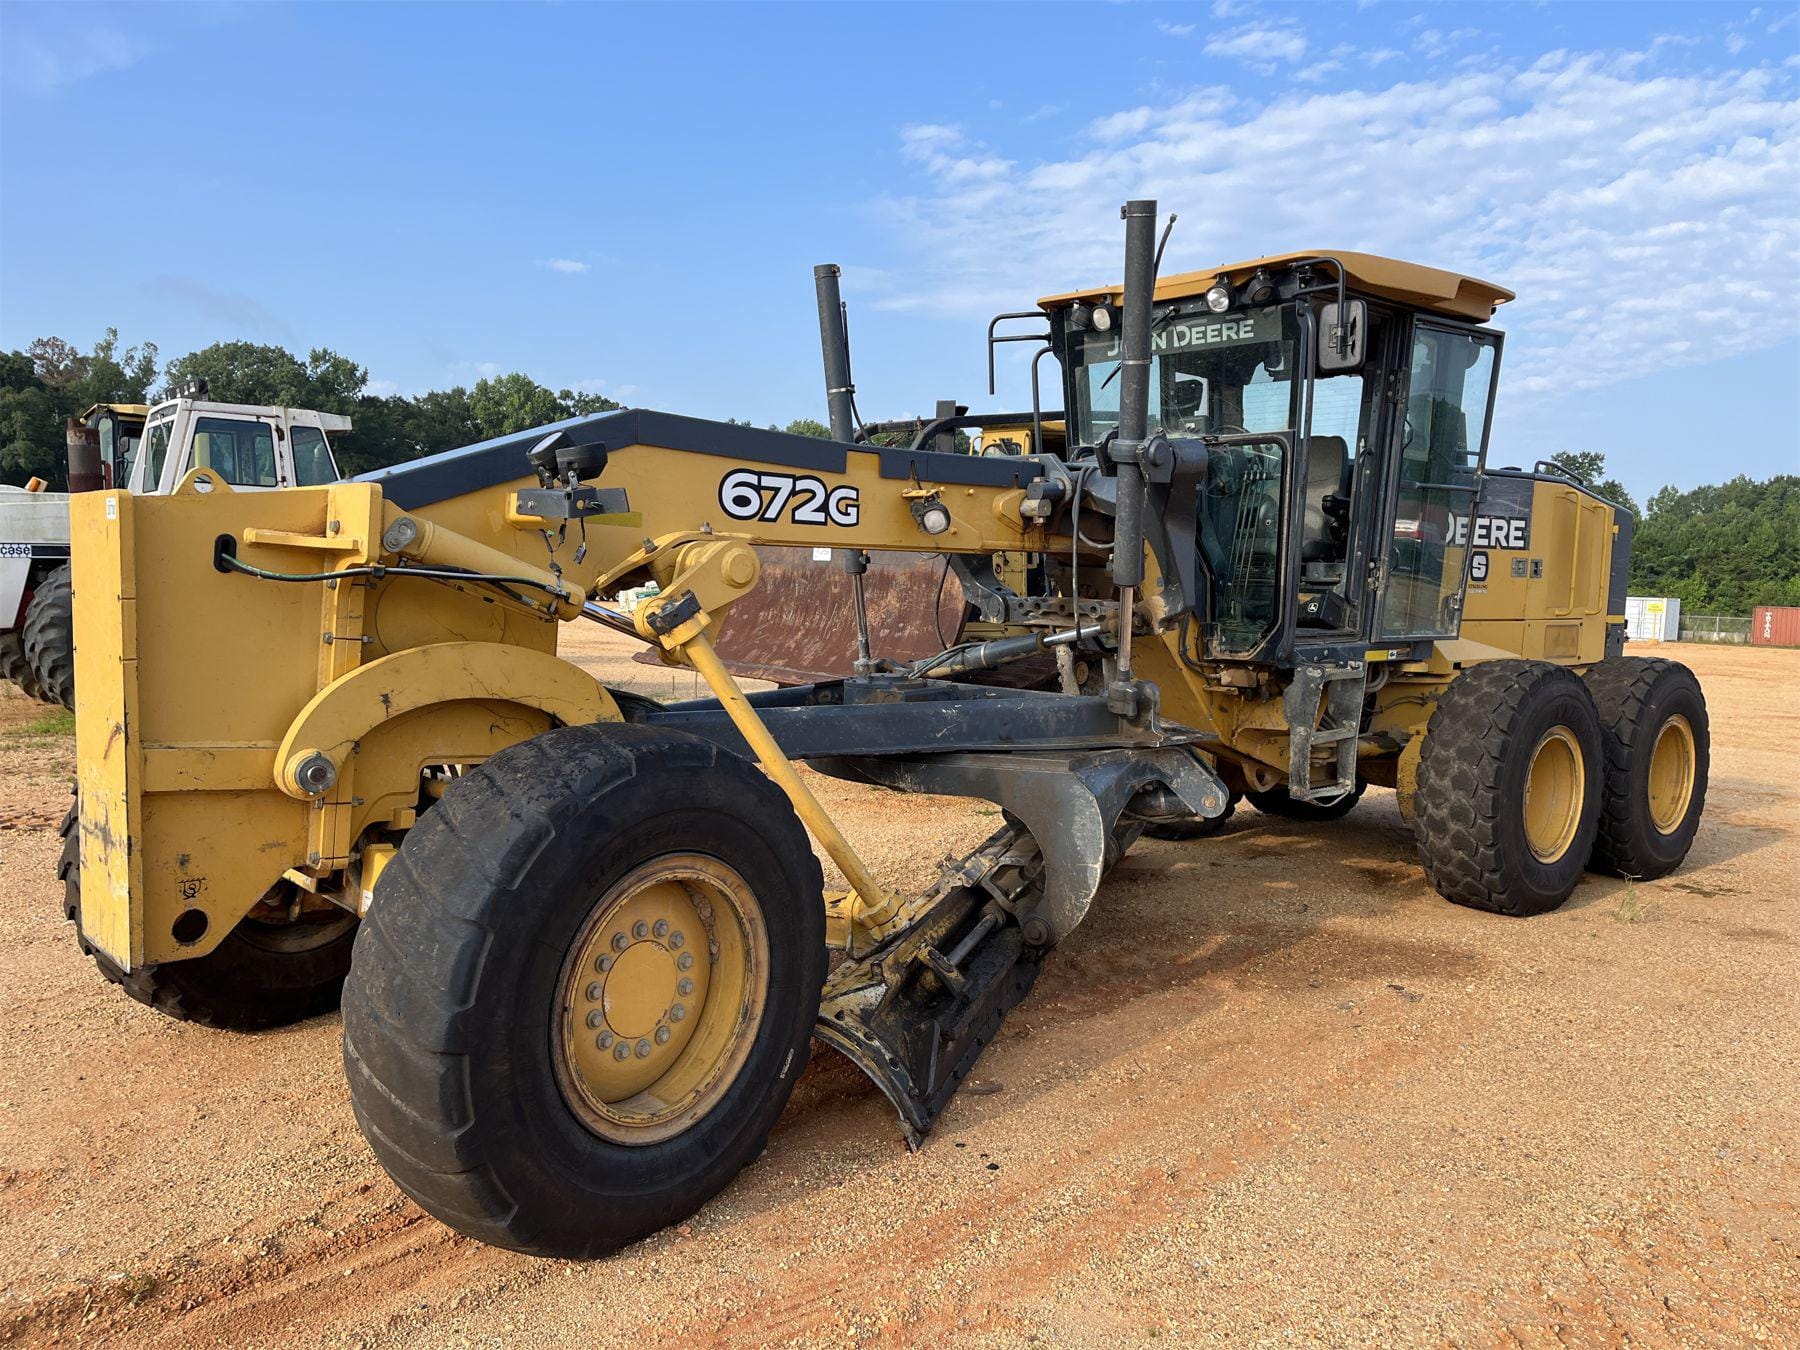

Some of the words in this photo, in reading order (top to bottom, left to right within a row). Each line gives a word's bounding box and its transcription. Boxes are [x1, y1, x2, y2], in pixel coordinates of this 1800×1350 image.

[1107, 333, 1167, 357] JN
[1173, 319, 1254, 348] DEERE
[719, 469, 860, 527] 672G
[1, 544, 31, 557] case
